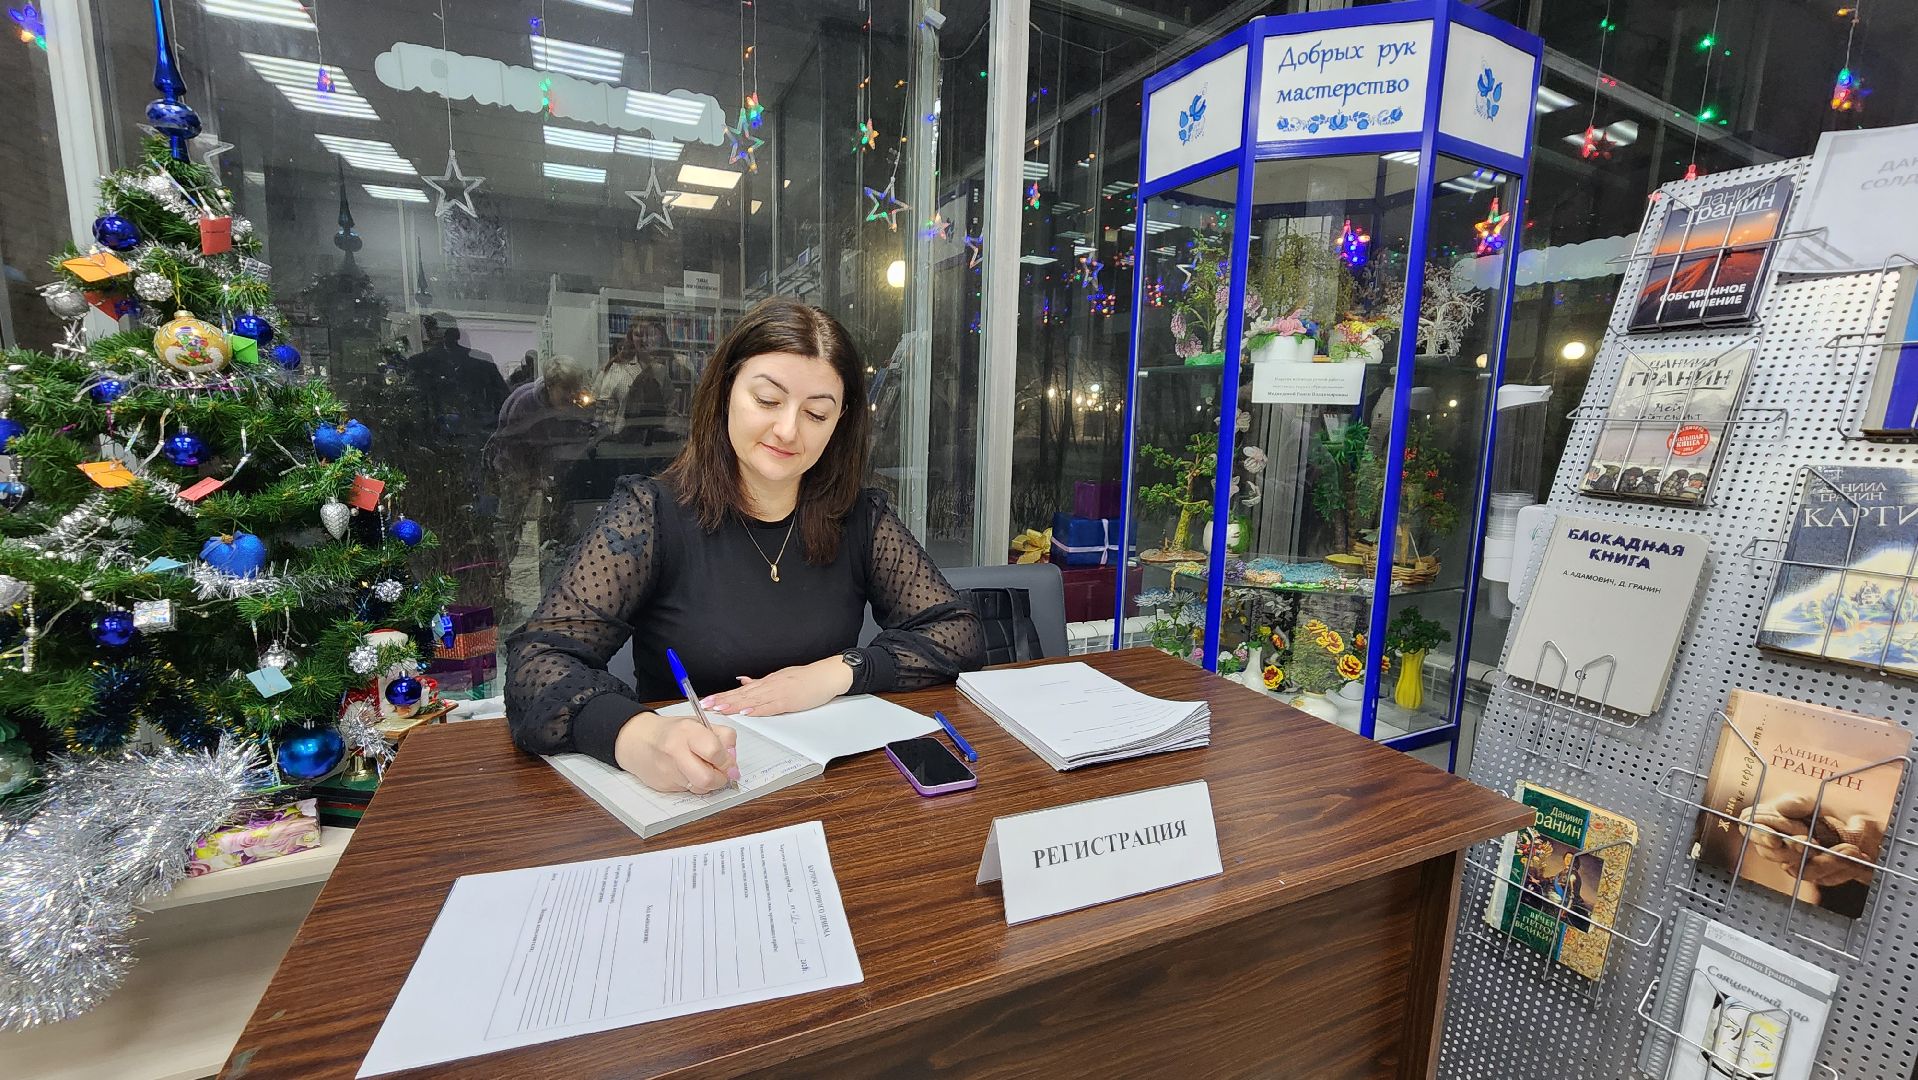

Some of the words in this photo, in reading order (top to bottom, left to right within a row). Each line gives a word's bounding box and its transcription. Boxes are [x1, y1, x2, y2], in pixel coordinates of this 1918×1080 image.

[1278, 39, 1364, 74] Добрых
[1377, 40, 1417, 67] рук
[1276, 78, 1410, 107] мастерство
[1567, 528, 1685, 557] БЛОКАДНАЯ
[1589, 548, 1651, 570] КНИГА
[1628, 582, 1662, 594] ГРАНИН
[1773, 743, 1839, 768] ДАНИИЛ
[1551, 806, 1584, 826] Даниил
[1717, 796, 1737, 833] Жзнь
[1032, 819, 1188, 869] РЕГИСТРАЦИЯ
[1530, 911, 1559, 930] ВЕЧЕР
